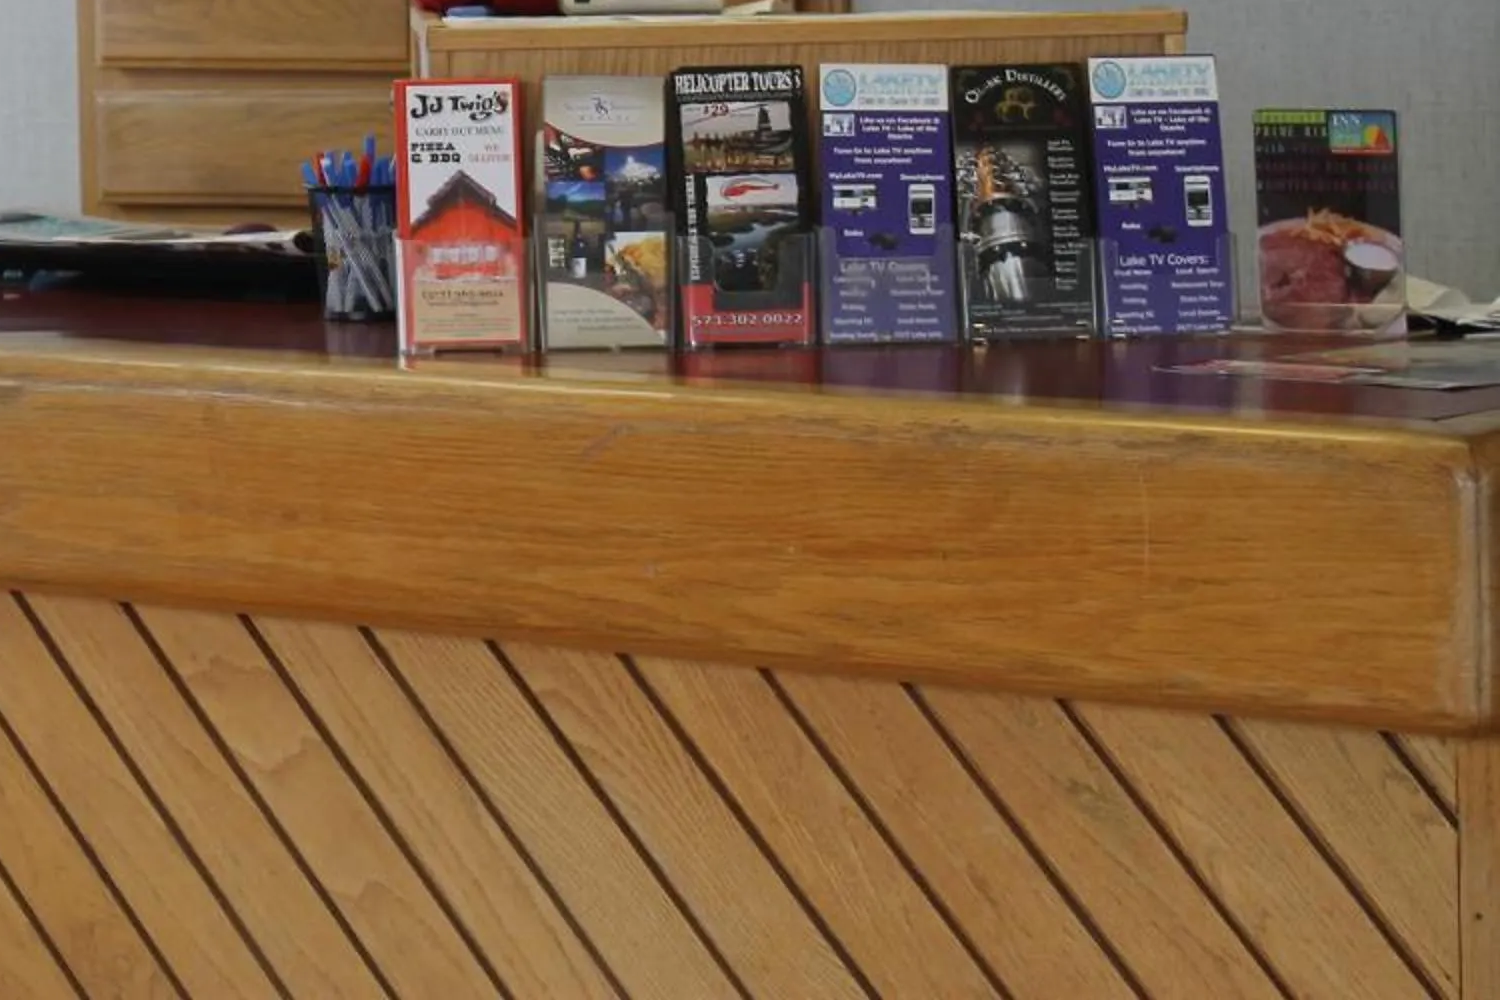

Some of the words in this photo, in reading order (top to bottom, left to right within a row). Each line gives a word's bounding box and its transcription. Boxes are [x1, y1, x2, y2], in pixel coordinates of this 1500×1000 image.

[675, 72, 749, 95] HELICOPTER
[751, 70, 793, 91] TOURS
[410, 93, 443, 119] JJ
[447, 90, 509, 122] Twig's
[411, 142, 456, 152] PIZZA
[429, 153, 461, 163] BBQ
[1120, 255, 1147, 267] Lake
[1148, 254, 1165, 265] TV
